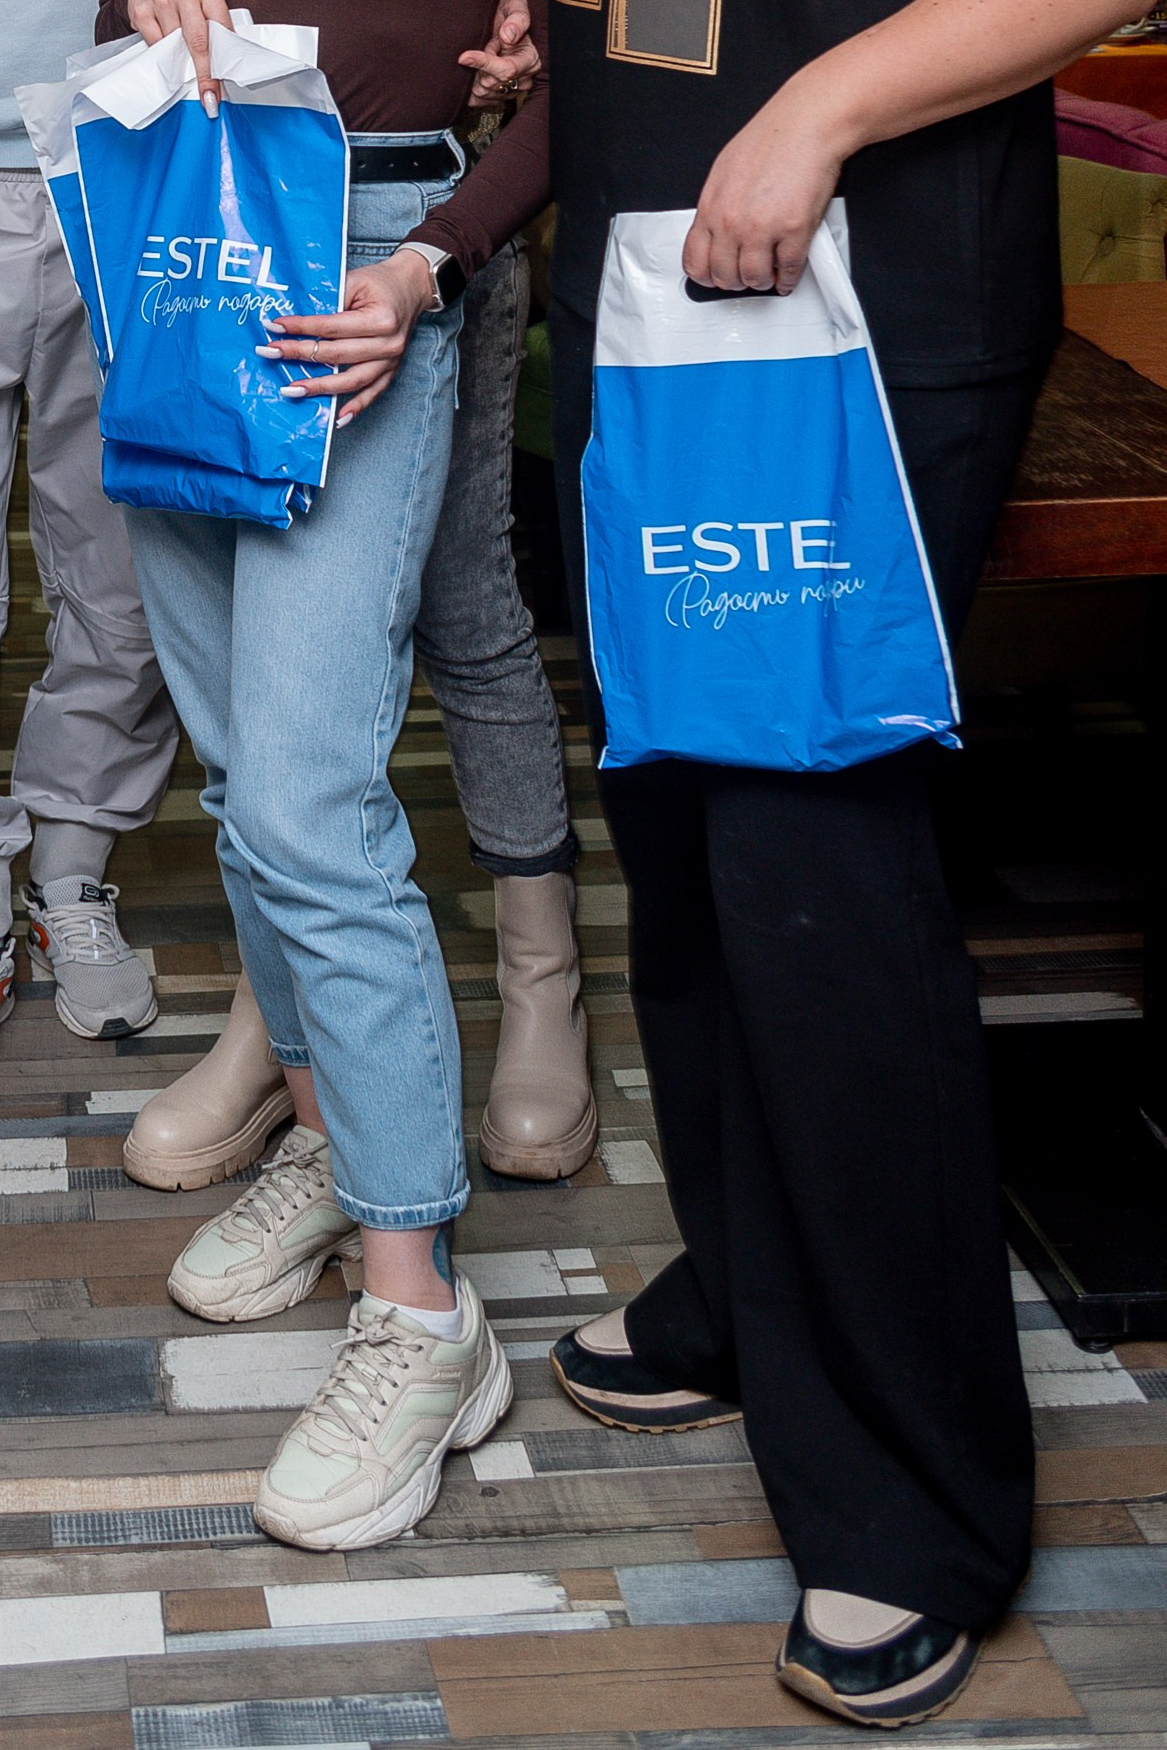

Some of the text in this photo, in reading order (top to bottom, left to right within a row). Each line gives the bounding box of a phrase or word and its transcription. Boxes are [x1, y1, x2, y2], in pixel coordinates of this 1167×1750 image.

[137, 235, 289, 291] ESTEL
[218, 292, 294, 325] подари
[641, 519, 851, 575] ESTE
[665, 570, 791, 630] Радость
